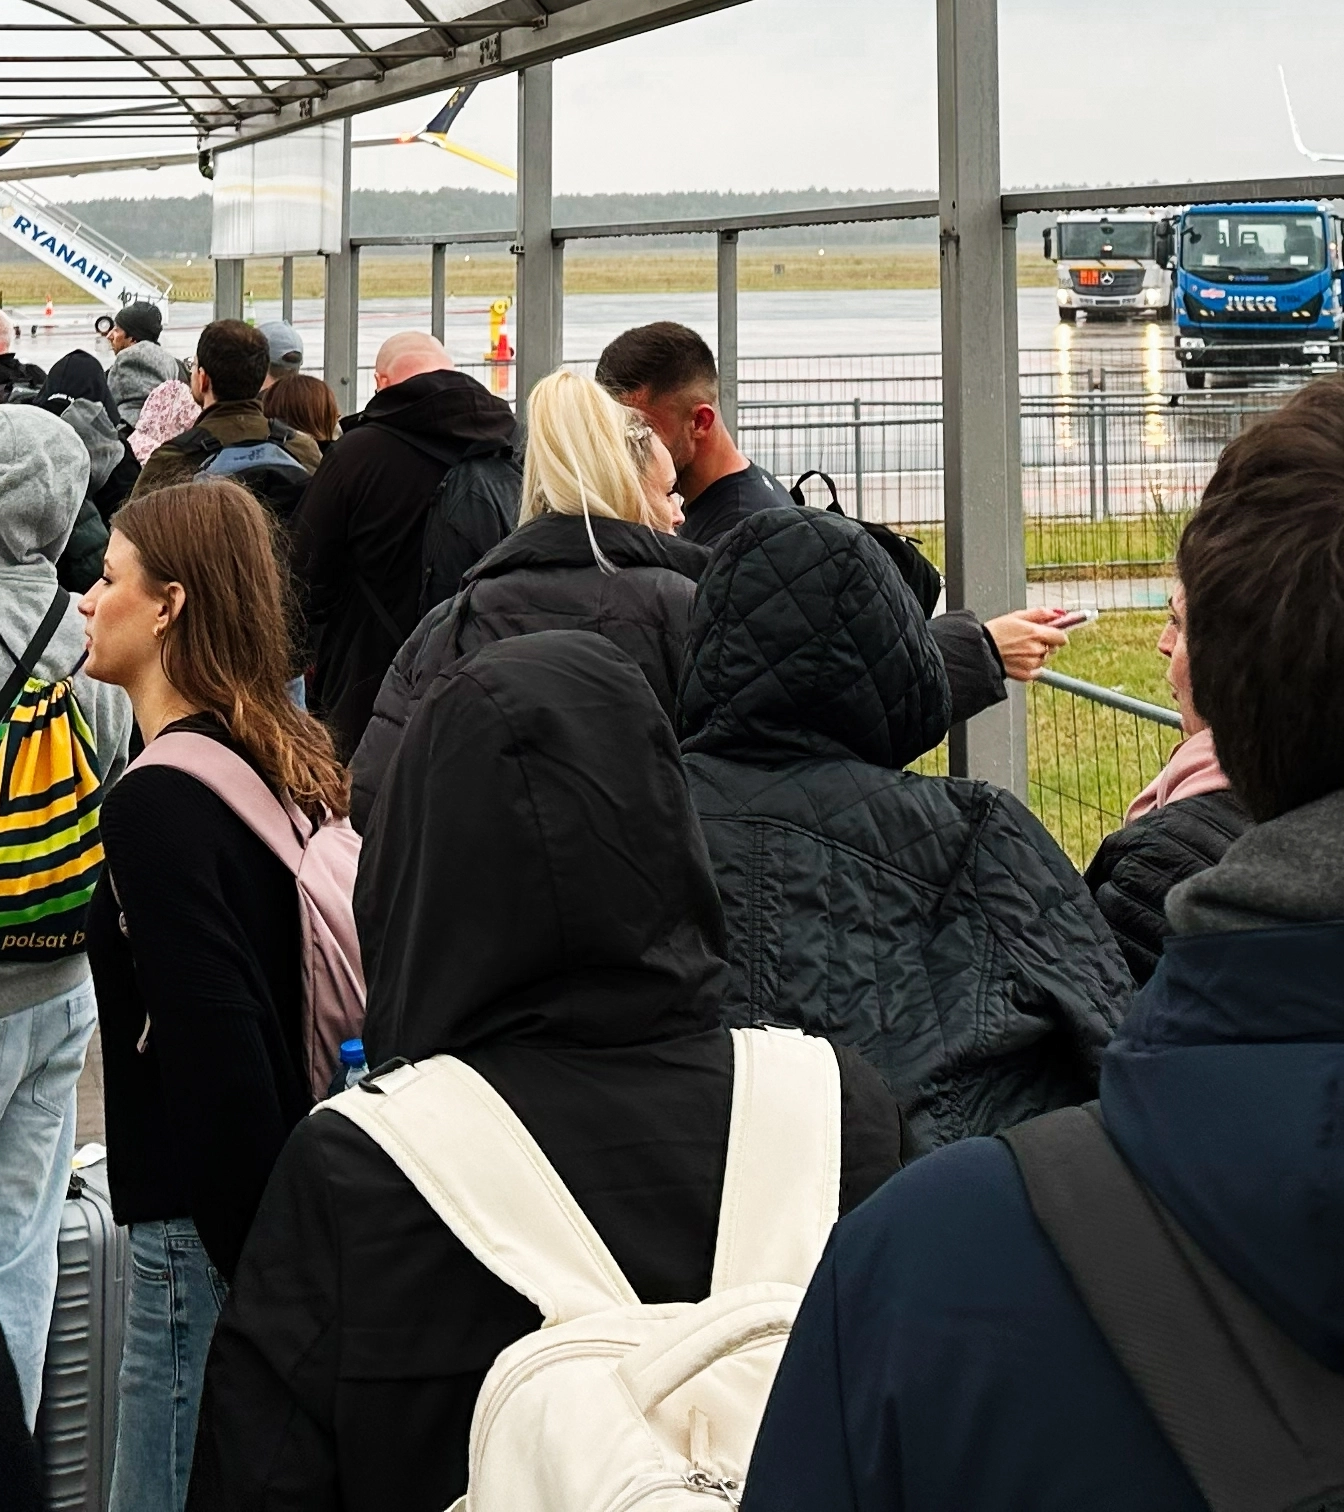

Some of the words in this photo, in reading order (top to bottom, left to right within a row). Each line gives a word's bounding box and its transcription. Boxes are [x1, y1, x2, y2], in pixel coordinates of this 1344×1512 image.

[12, 214, 113, 289] RYANAIR
[1226, 295, 1277, 312] IVECO
[1, 932, 67, 950] polsat
